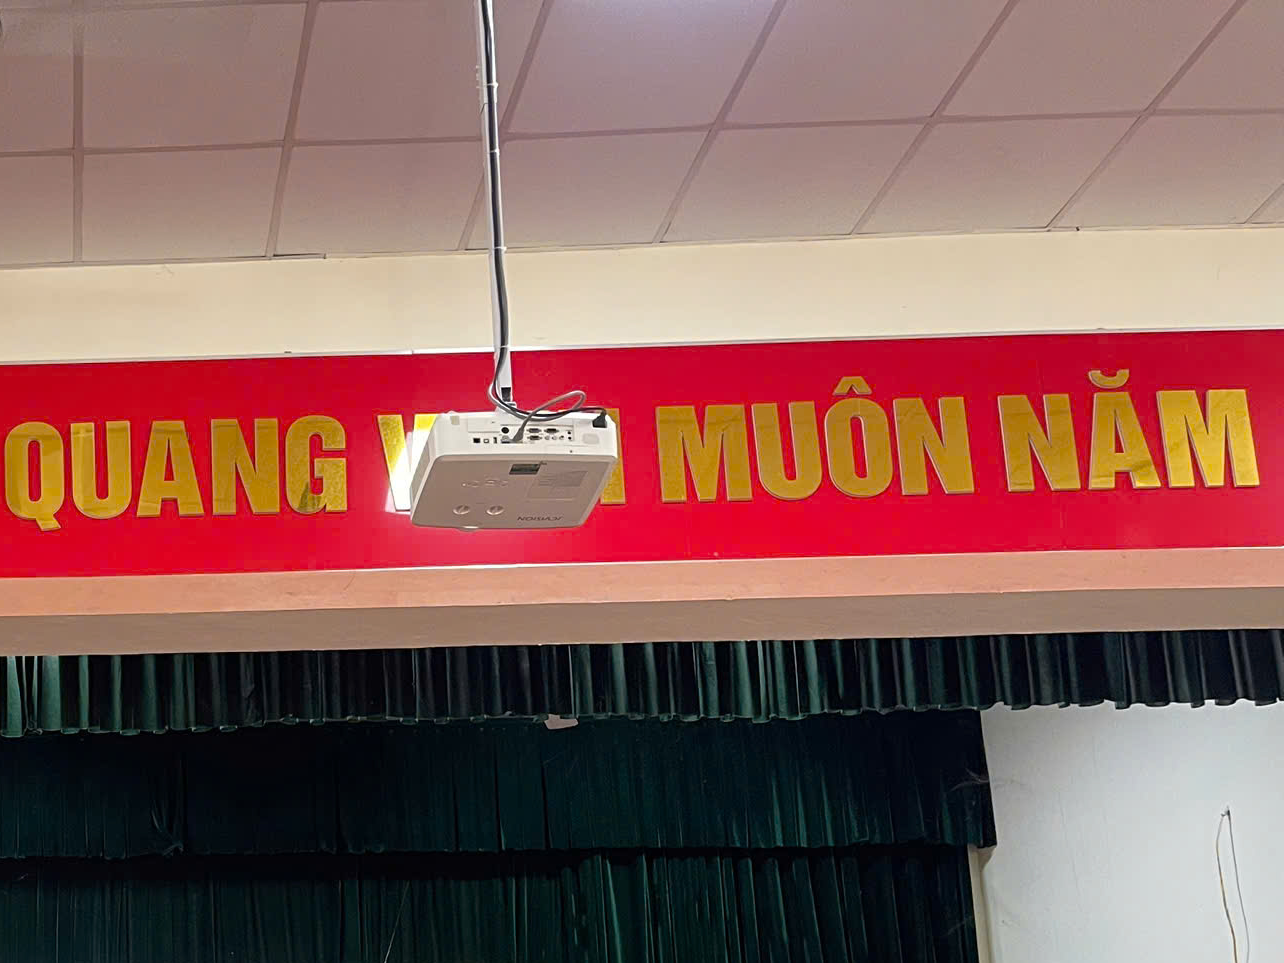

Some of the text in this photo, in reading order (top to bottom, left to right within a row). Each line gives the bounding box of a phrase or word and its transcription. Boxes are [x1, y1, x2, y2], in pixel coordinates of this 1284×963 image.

[4, 414, 348, 532] QUANG
[655, 375, 975, 503] MUÔN
[997, 368, 1261, 493] NĂM
